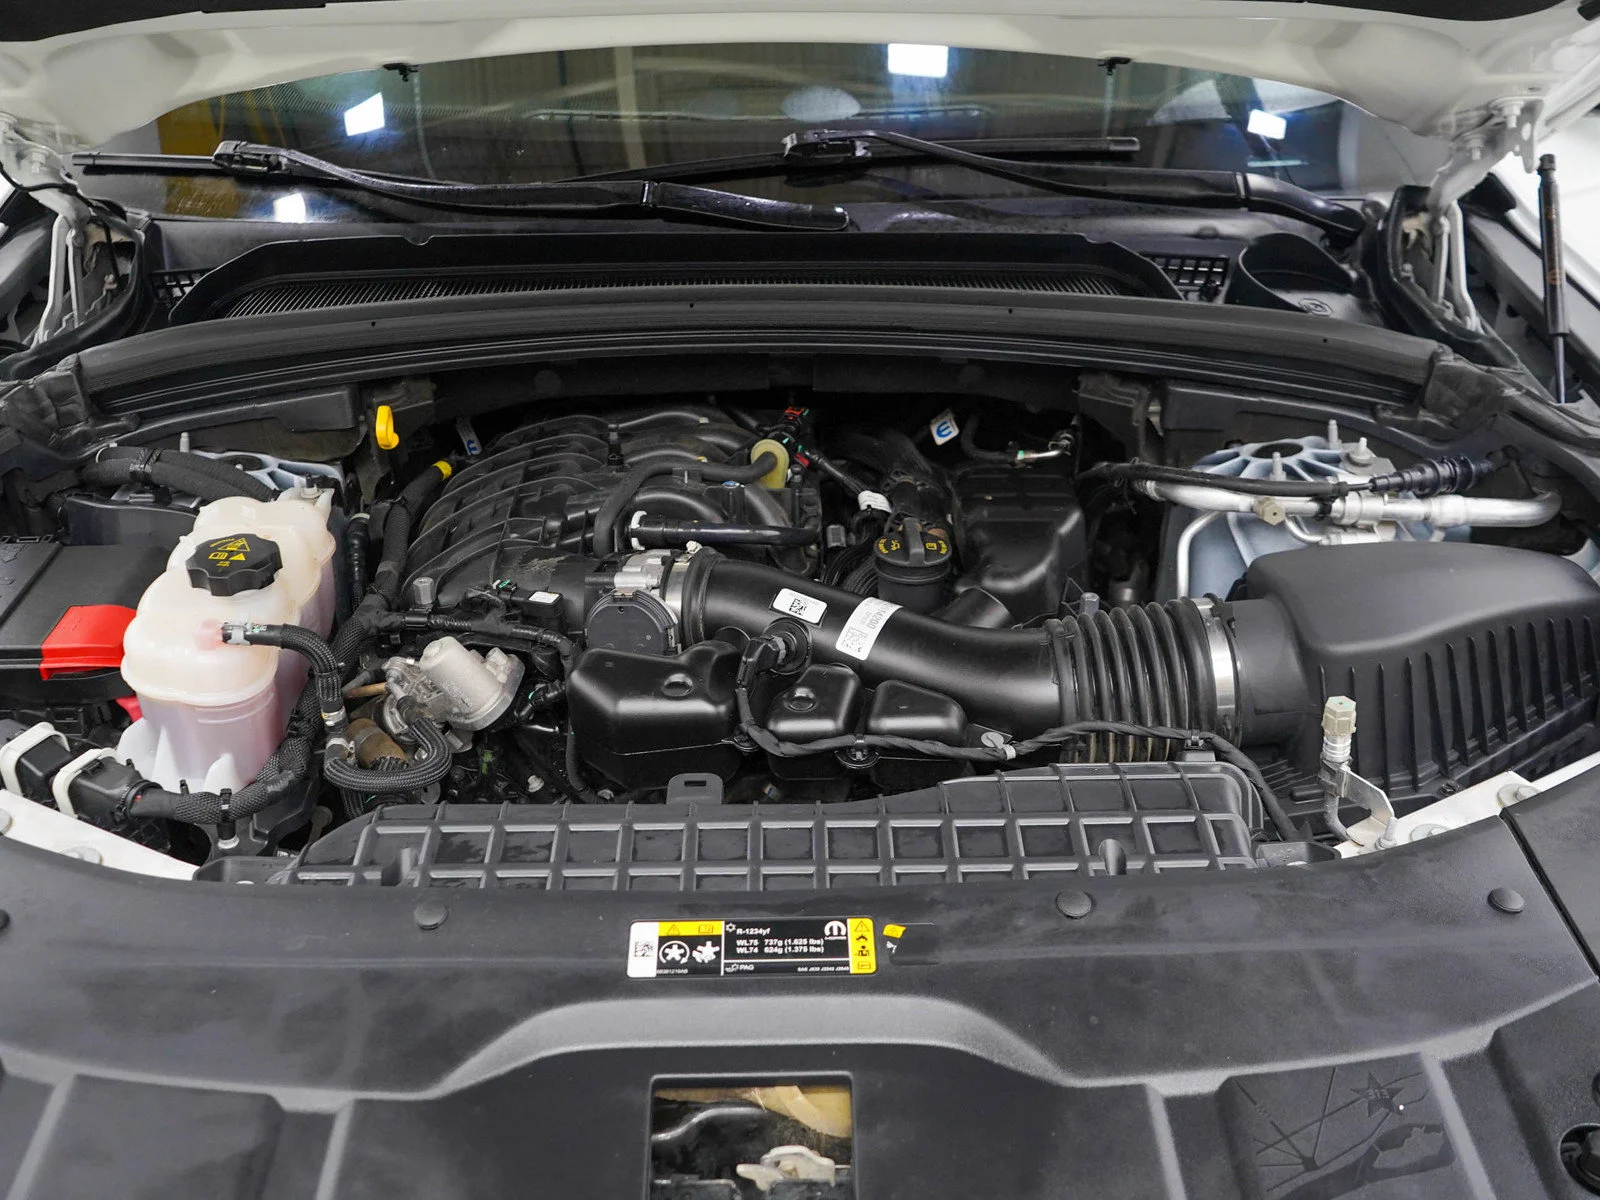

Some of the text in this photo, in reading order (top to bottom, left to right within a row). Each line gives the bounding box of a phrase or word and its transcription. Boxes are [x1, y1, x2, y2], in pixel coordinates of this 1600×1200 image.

[736, 928, 771, 936] R-1234yf
[764, 939, 783, 947] 737g
[784, 938, 808, 946] (1.625
[809, 938, 824, 946] lbs)
[764, 946, 783, 954] 624g
[784, 946, 808, 954] (1.375
[809, 945, 824, 954] lbs)
